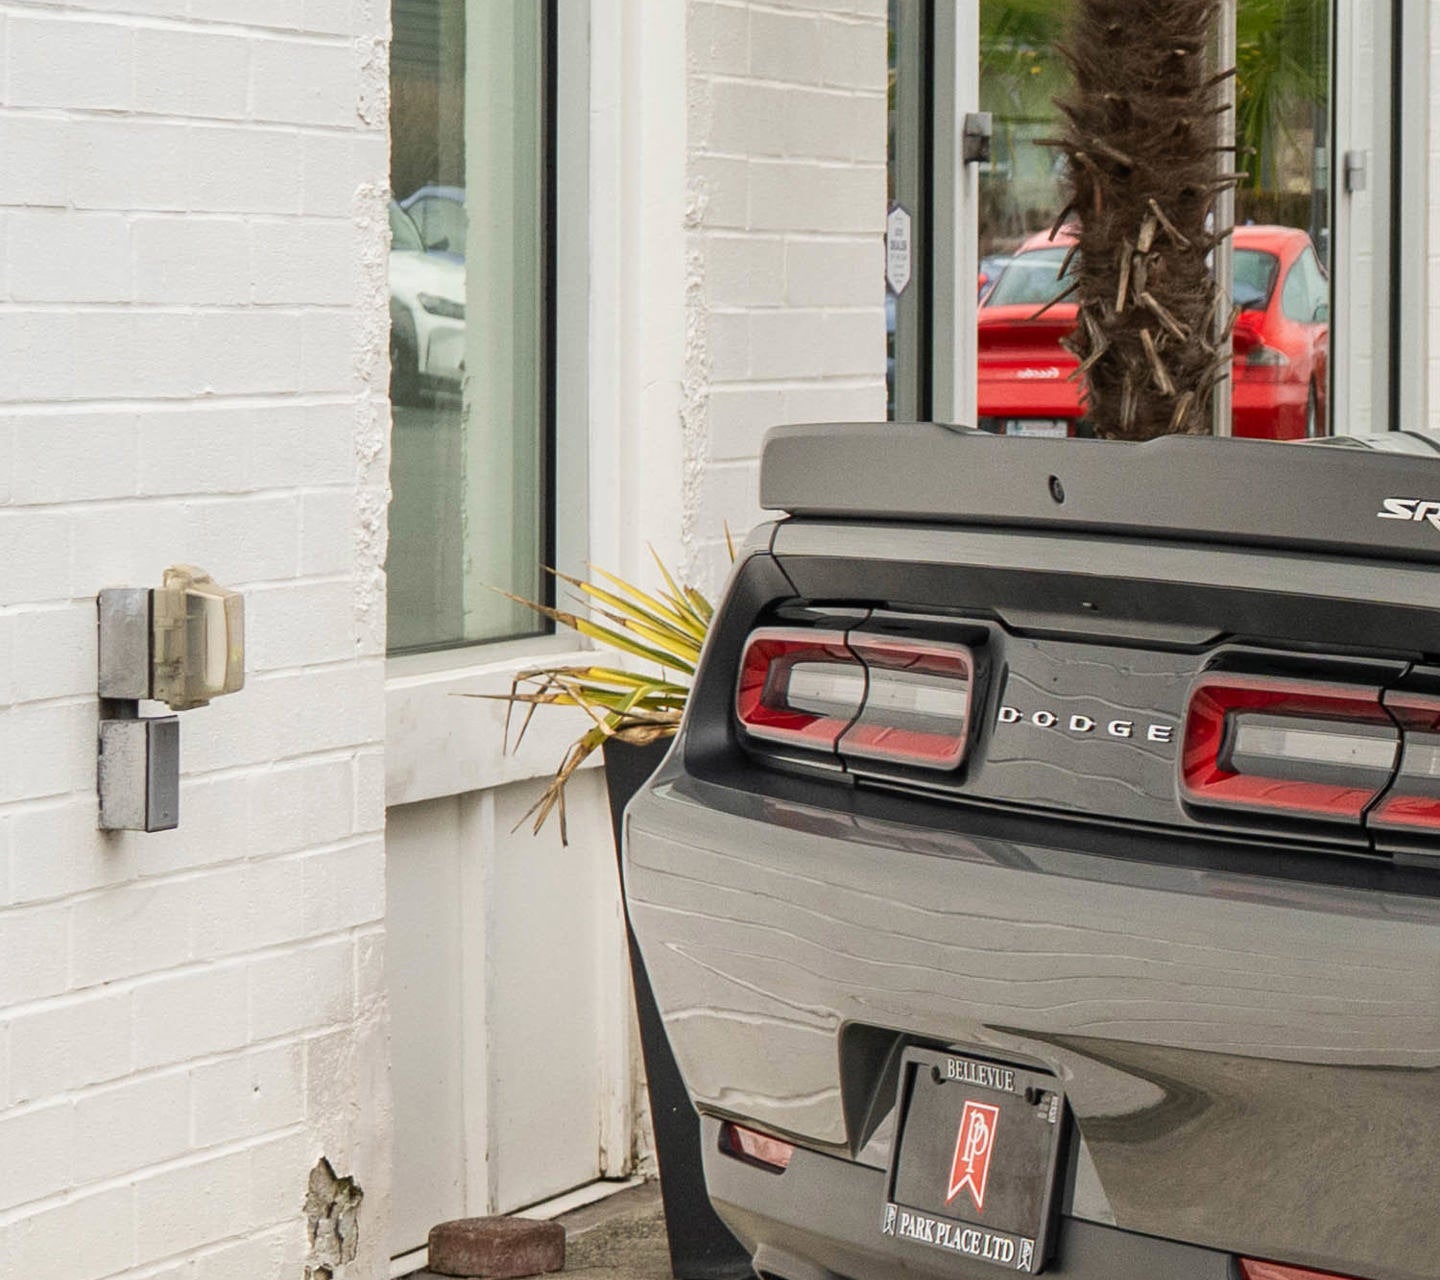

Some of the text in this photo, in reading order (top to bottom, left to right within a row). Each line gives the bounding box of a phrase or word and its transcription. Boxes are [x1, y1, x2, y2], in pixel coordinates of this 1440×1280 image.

[998, 706, 1173, 743] DODGE
[947, 1058, 1016, 1092] BELLEVUE
[899, 1212, 936, 1243] PARK
[935, 1223, 982, 1252] PLACE
[982, 1236, 1015, 1263] LTD
